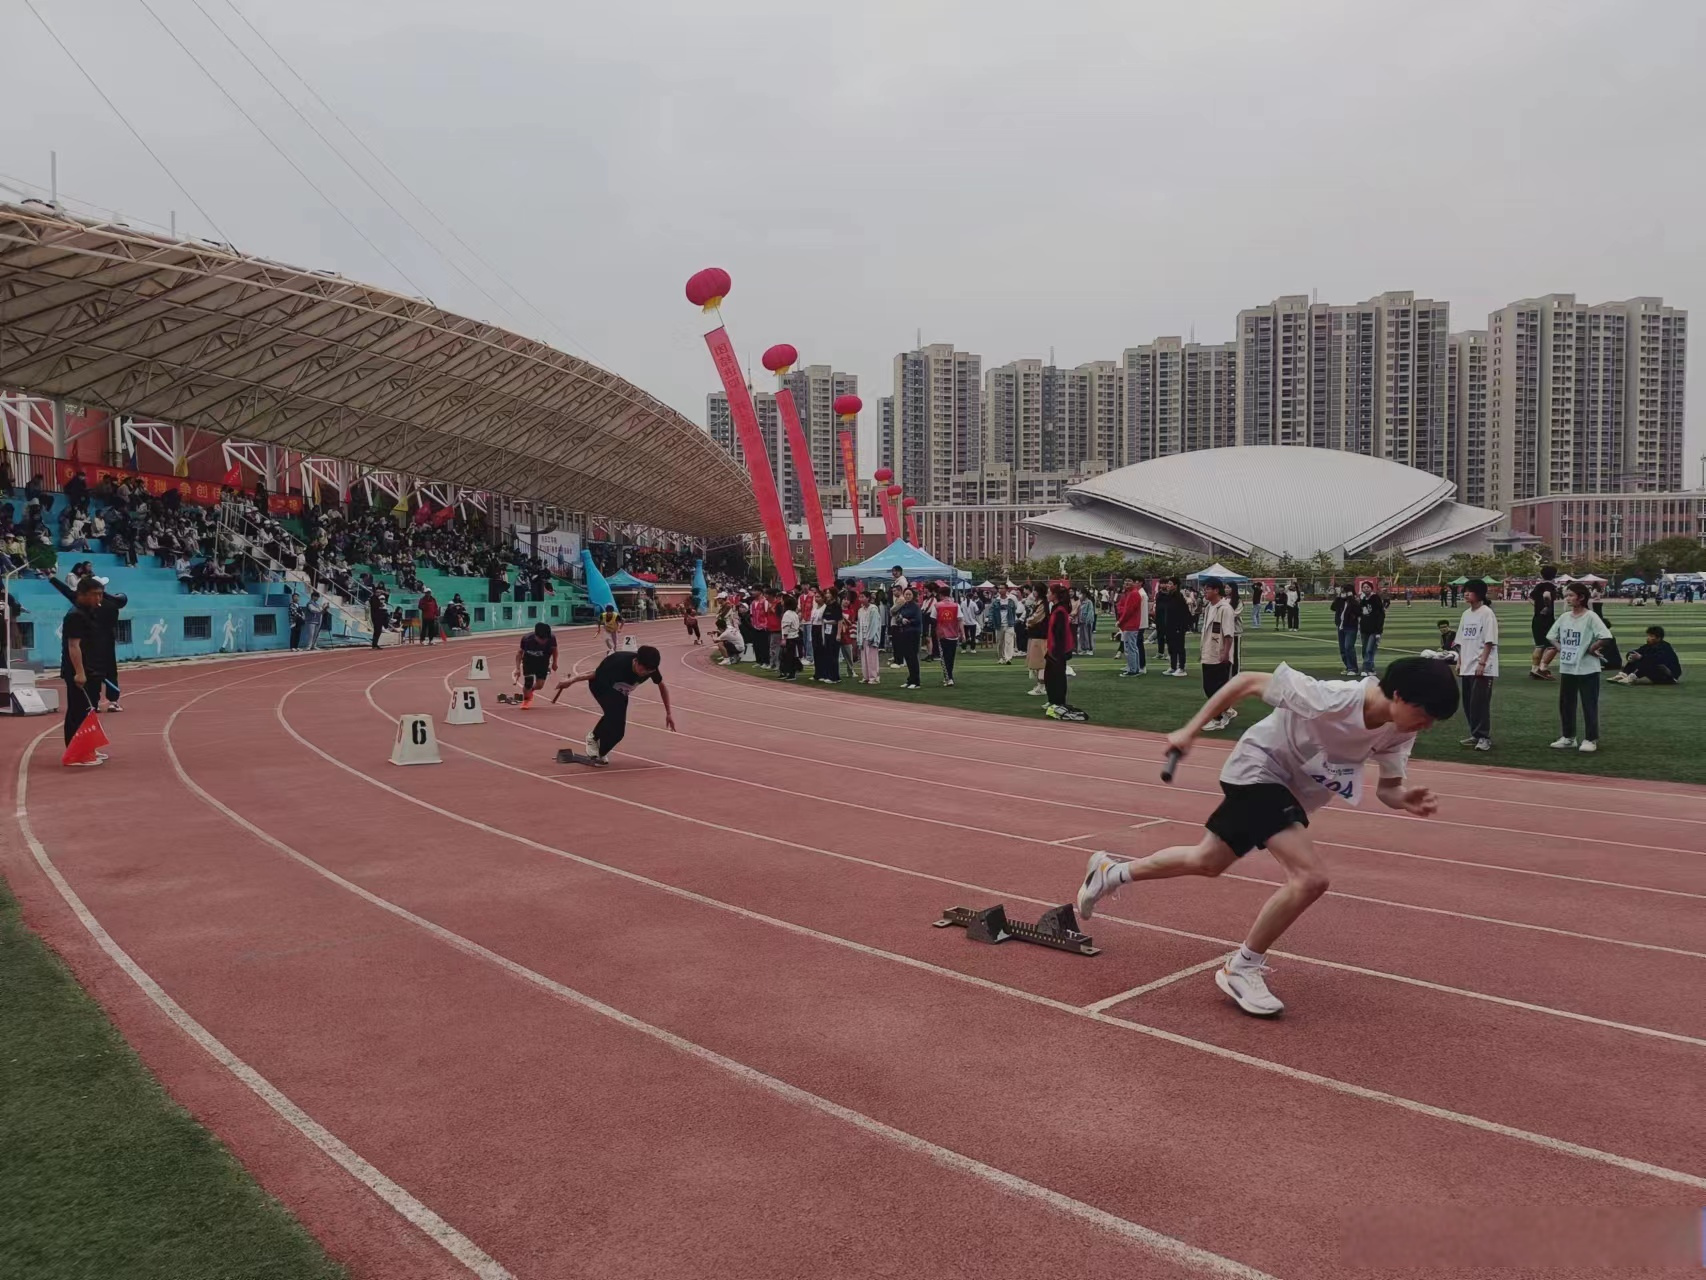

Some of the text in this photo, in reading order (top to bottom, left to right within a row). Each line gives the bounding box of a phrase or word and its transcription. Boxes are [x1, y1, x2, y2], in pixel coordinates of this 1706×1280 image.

[1463, 627, 1477, 637] 390
[625, 636, 631, 646] 2
[476, 659, 485, 671] 4
[463, 691, 476, 710] 5
[412, 719, 427, 744] 6
